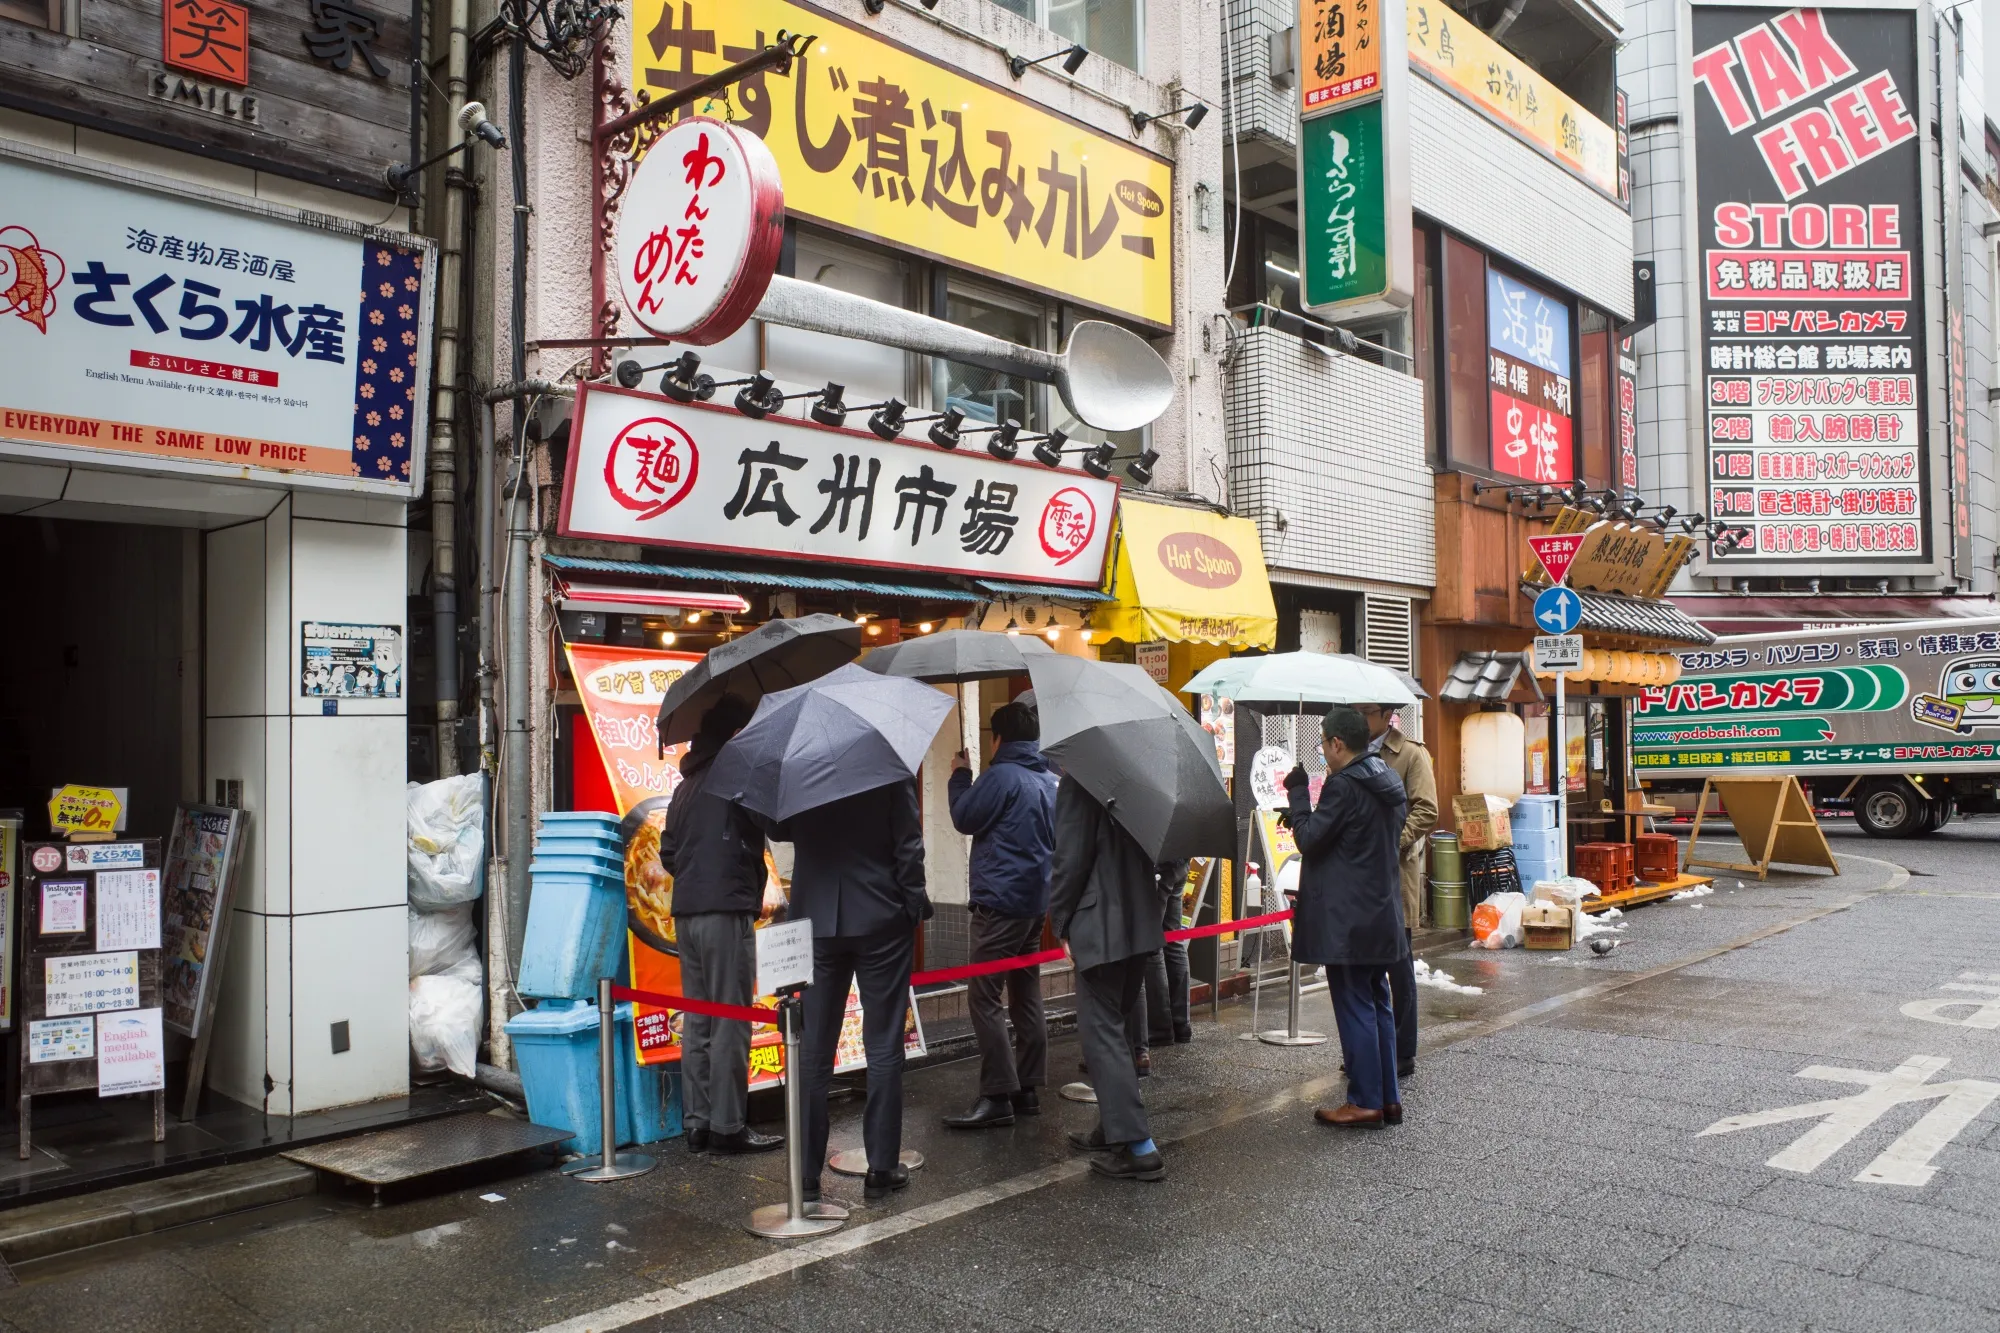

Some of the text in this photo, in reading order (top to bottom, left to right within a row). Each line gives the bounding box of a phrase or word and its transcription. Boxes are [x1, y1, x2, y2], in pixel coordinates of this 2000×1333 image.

[173, 0, 242, 73] 笑
[303, 0, 391, 77] 家
[1315, 0, 1346, 80] 酒場
[1406, 7, 1455, 68] き鳥
[1693, 7, 1859, 135] TAX
[154, 73, 256, 119] SMILE
[1308, 76, 1374, 104] 朝まで営業中
[1486, 62, 1539, 126] お刺身
[645, 0, 1155, 260] 牛すじ煮込みカレー
[1753, 68, 1918, 202] FREE
[675, 132, 726, 286] わんたん
[1119, 184, 1161, 213] Hot Spoon
[1326, 130, 1356, 279] ふらんす亭
[1714, 202, 1901, 249] STORE
[126, 226, 296, 284] 海産物居酒屋
[633, 224, 673, 315] めん
[1716, 259, 1903, 291] 免税品取扱店
[71, 262, 346, 365] さくら水産
[1498, 276, 1560, 371] 活魚
[1713, 318, 1739, 332] 本店
[1744, 310, 1908, 333] ヨドバシカメラ
[148, 354, 260, 383] おいしさと健康
[1711, 344, 1912, 369] 時計総合館 売場案内
[86, 368, 119, 381] English
[120, 374, 144, 385] Menu
[146, 378, 183, 391] Available
[1509, 364, 1528, 395] 4階
[1712, 376, 1913, 405] 3階 ブランドバッグ・筆記具
[1620, 376, 1636, 489] 時計館
[1712, 413, 1903, 442] 2階 輸入腕時計
[1951, 304, 1968, 538] G-SHOCK
[5, 412, 307, 463] EVERYDAY THE SAME LOW PRICE
[1504, 399, 1558, 480] 串焼
[626, 434, 680, 494] 麺
[1715, 451, 1915, 480] 1階 国産腕時計・スポーツウォッチ
[723, 440, 1019, 556] 広州市場
[1758, 487, 1916, 516] 置き時計・掛け時計
[1048, 497, 1087, 547] 雲呑
[1540, 540, 1574, 553] 止まれ
[1760, 524, 1918, 553] 時計修理・時計電池交換
[1166, 544, 1236, 579] Hot Spoon
[1545, 554, 1570, 565] STOP
[1180, 616, 1246, 638] 牛すじ煮込みカレー
[1536, 637, 1580, 648] 自転車を除く
[1537, 648, 1580, 659] 一方通行
[1673, 631, 2000, 669] てカメラ・パソコン・家電・情報等を
[1138, 653, 1167, 665] 11:00
[596, 670, 645, 694] コク旨
[1634, 677, 1824, 714] ドバシカメラ
[1634, 725, 1780, 743] www.yodobashi.com
[1260, 752, 1283, 765] ごはん
[1633, 750, 1791, 766] 日配達・翌日配達・指定日配達
[78, 789, 101, 797] ランチ
[60, 804, 88, 813] おかわり
[34, 853, 59, 868] 5F
[92, 850, 142, 860] さくら水産
[45, 884, 83, 895] Instagram
[104, 1029, 147, 1042] English
[104, 1042, 137, 1053] menu
[104, 1050, 156, 1064] available
